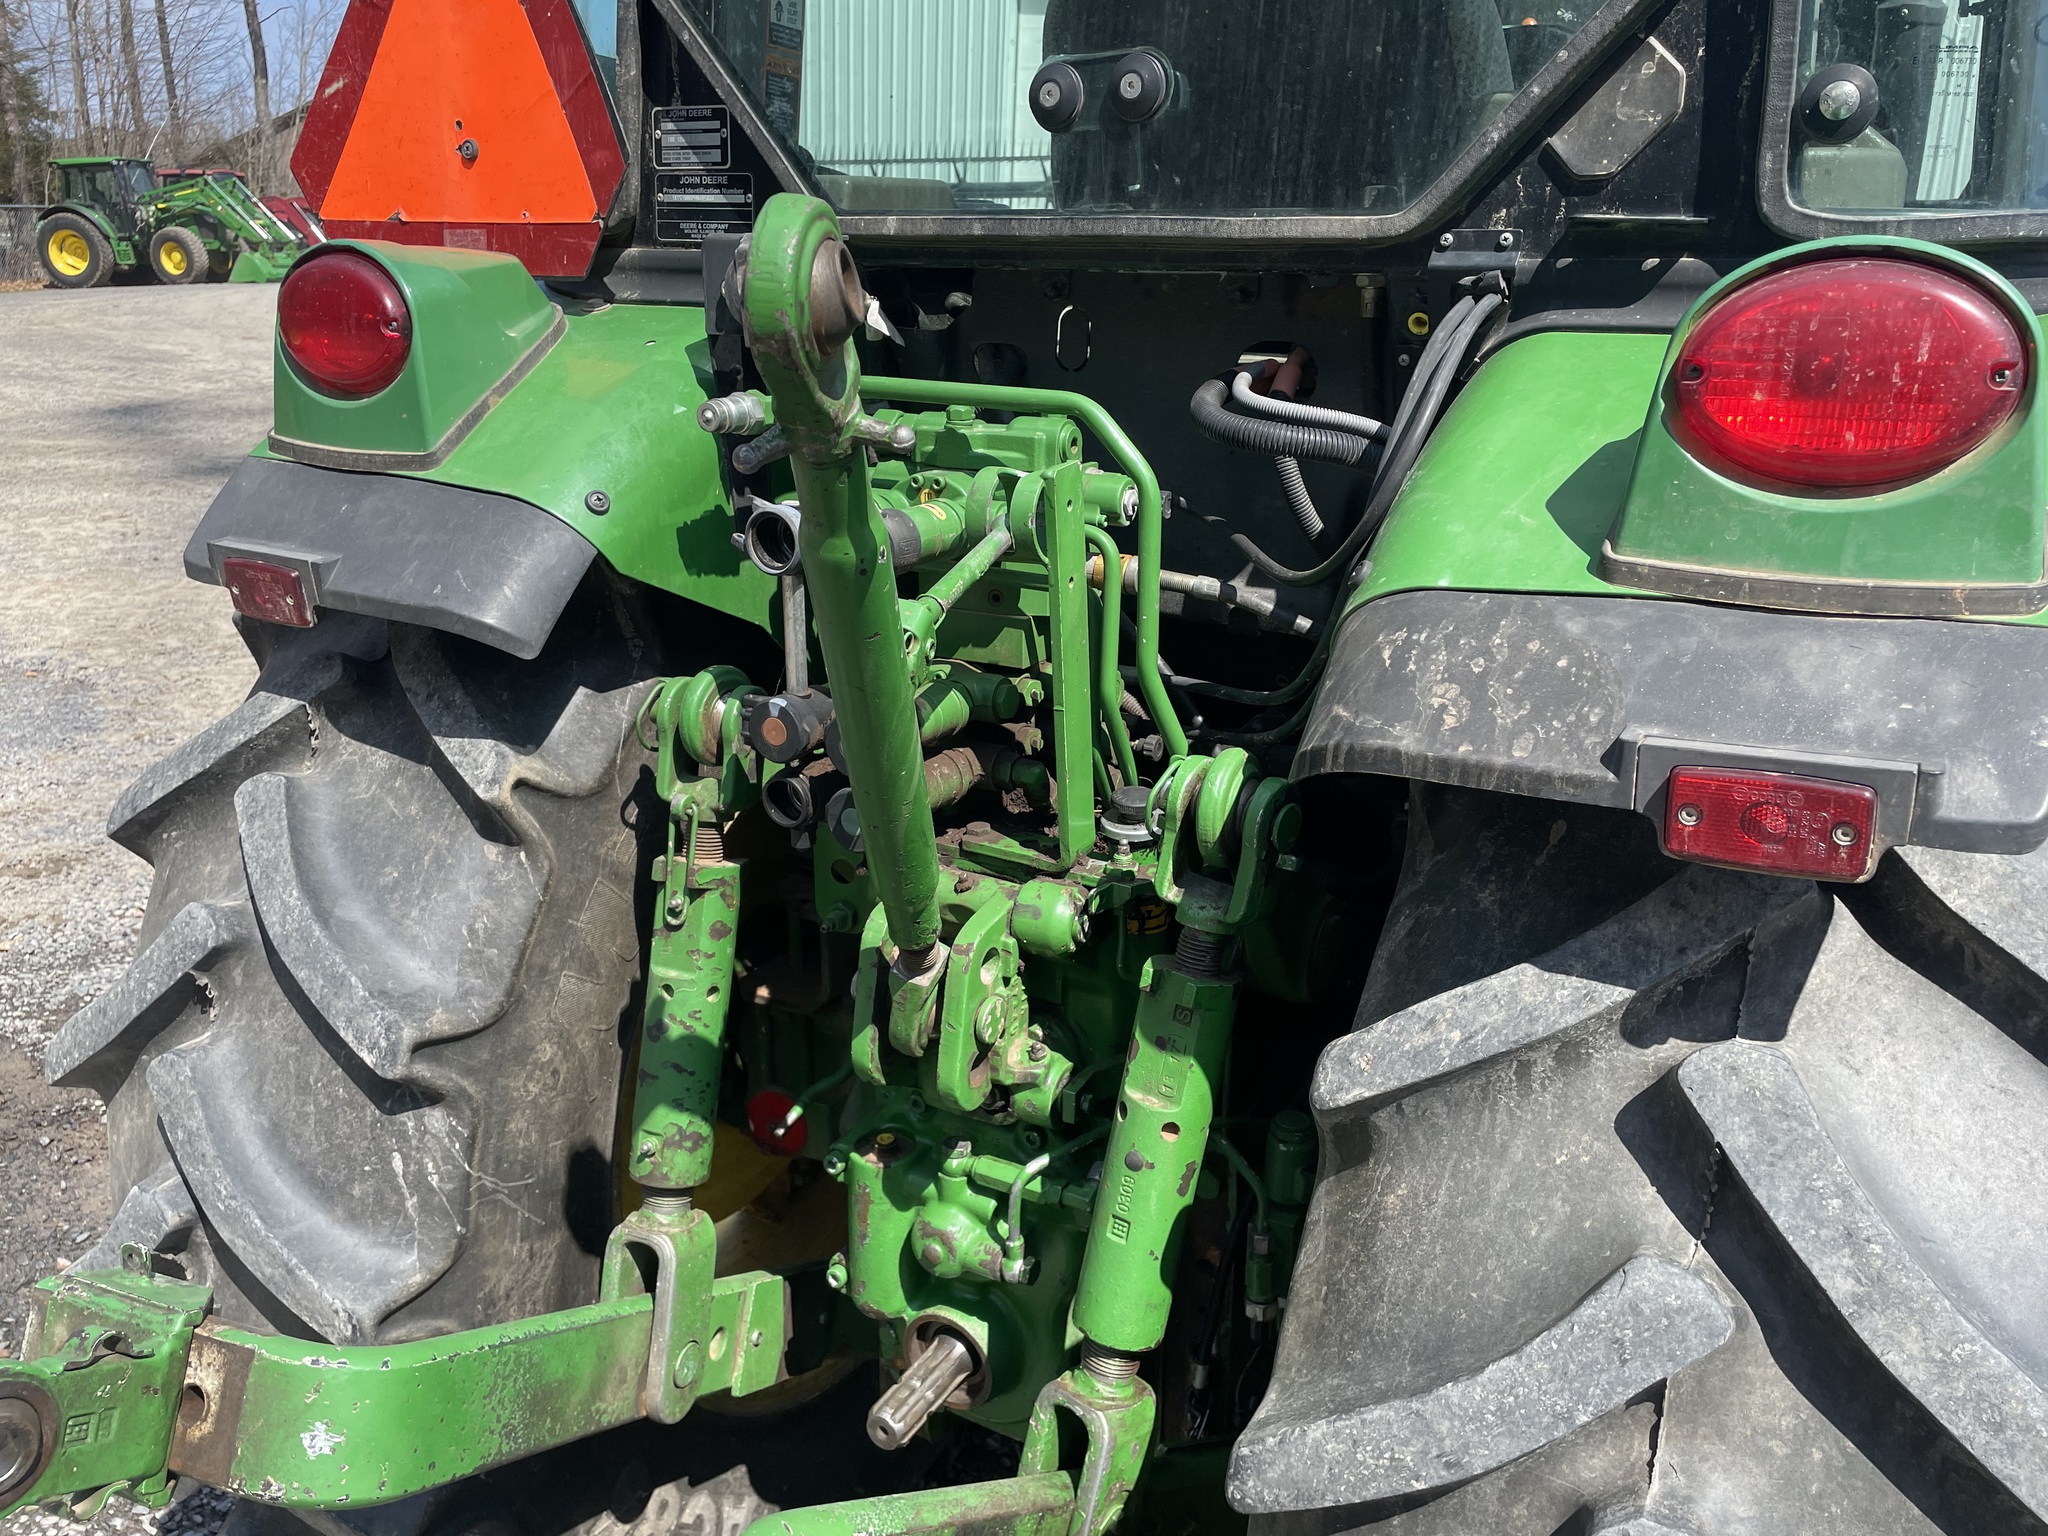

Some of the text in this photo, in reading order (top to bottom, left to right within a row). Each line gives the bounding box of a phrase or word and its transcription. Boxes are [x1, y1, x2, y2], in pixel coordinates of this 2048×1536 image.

[668, 109, 712, 117] JOHN DEERE
[679, 176, 728, 184] JOHN DEERE
[1116, 1175, 1135, 1215] 0309
